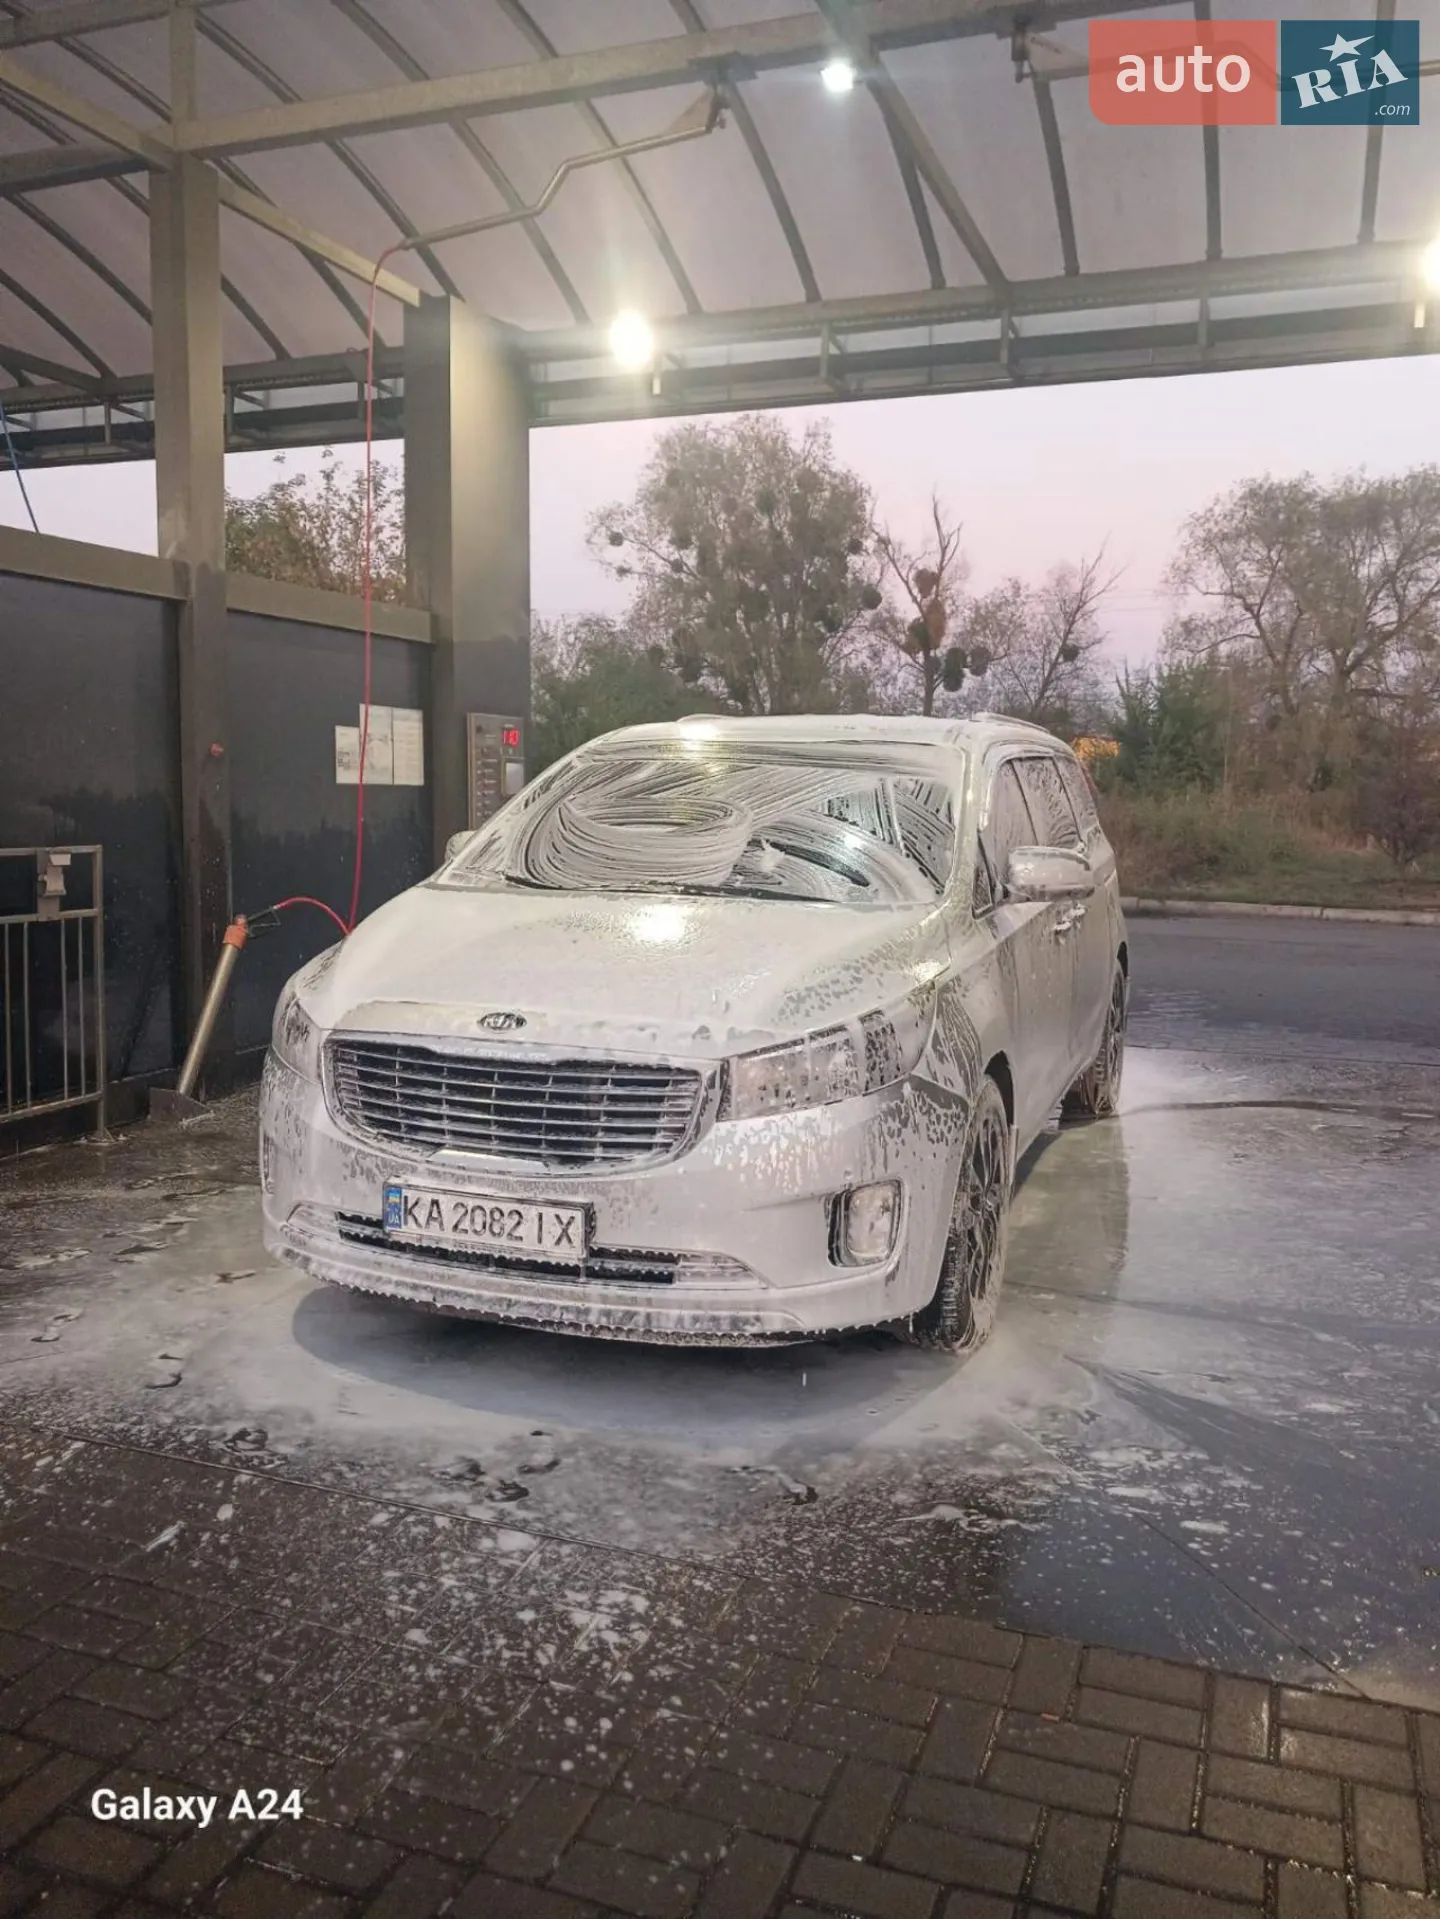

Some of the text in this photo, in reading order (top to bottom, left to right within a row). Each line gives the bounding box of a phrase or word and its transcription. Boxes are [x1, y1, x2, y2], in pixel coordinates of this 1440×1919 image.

[404, 1195, 576, 1248] KA 2082 IX
